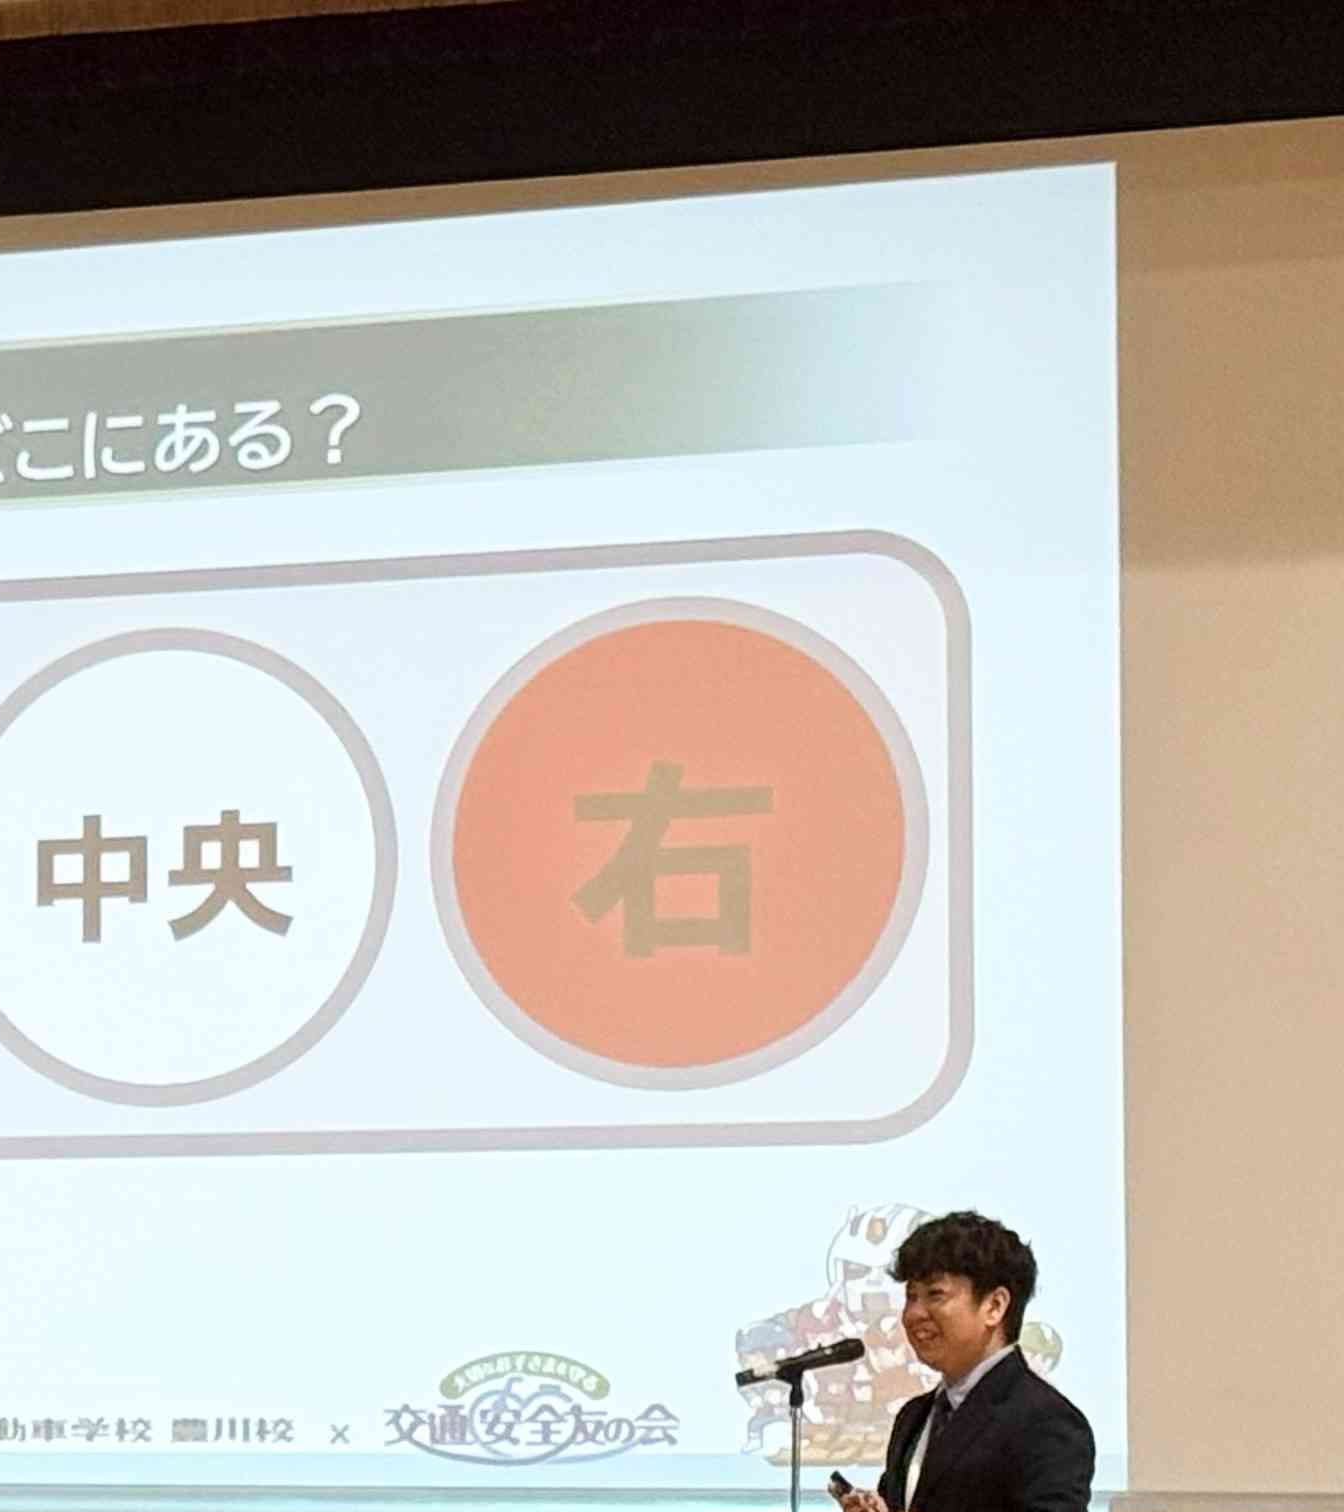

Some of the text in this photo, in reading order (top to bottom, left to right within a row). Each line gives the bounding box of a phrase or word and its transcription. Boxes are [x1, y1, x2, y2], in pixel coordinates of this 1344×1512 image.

[36, 808, 294, 944] 中央
[570, 759, 775, 959] 右
[384, 1402, 680, 1447] 交通安全友の会
